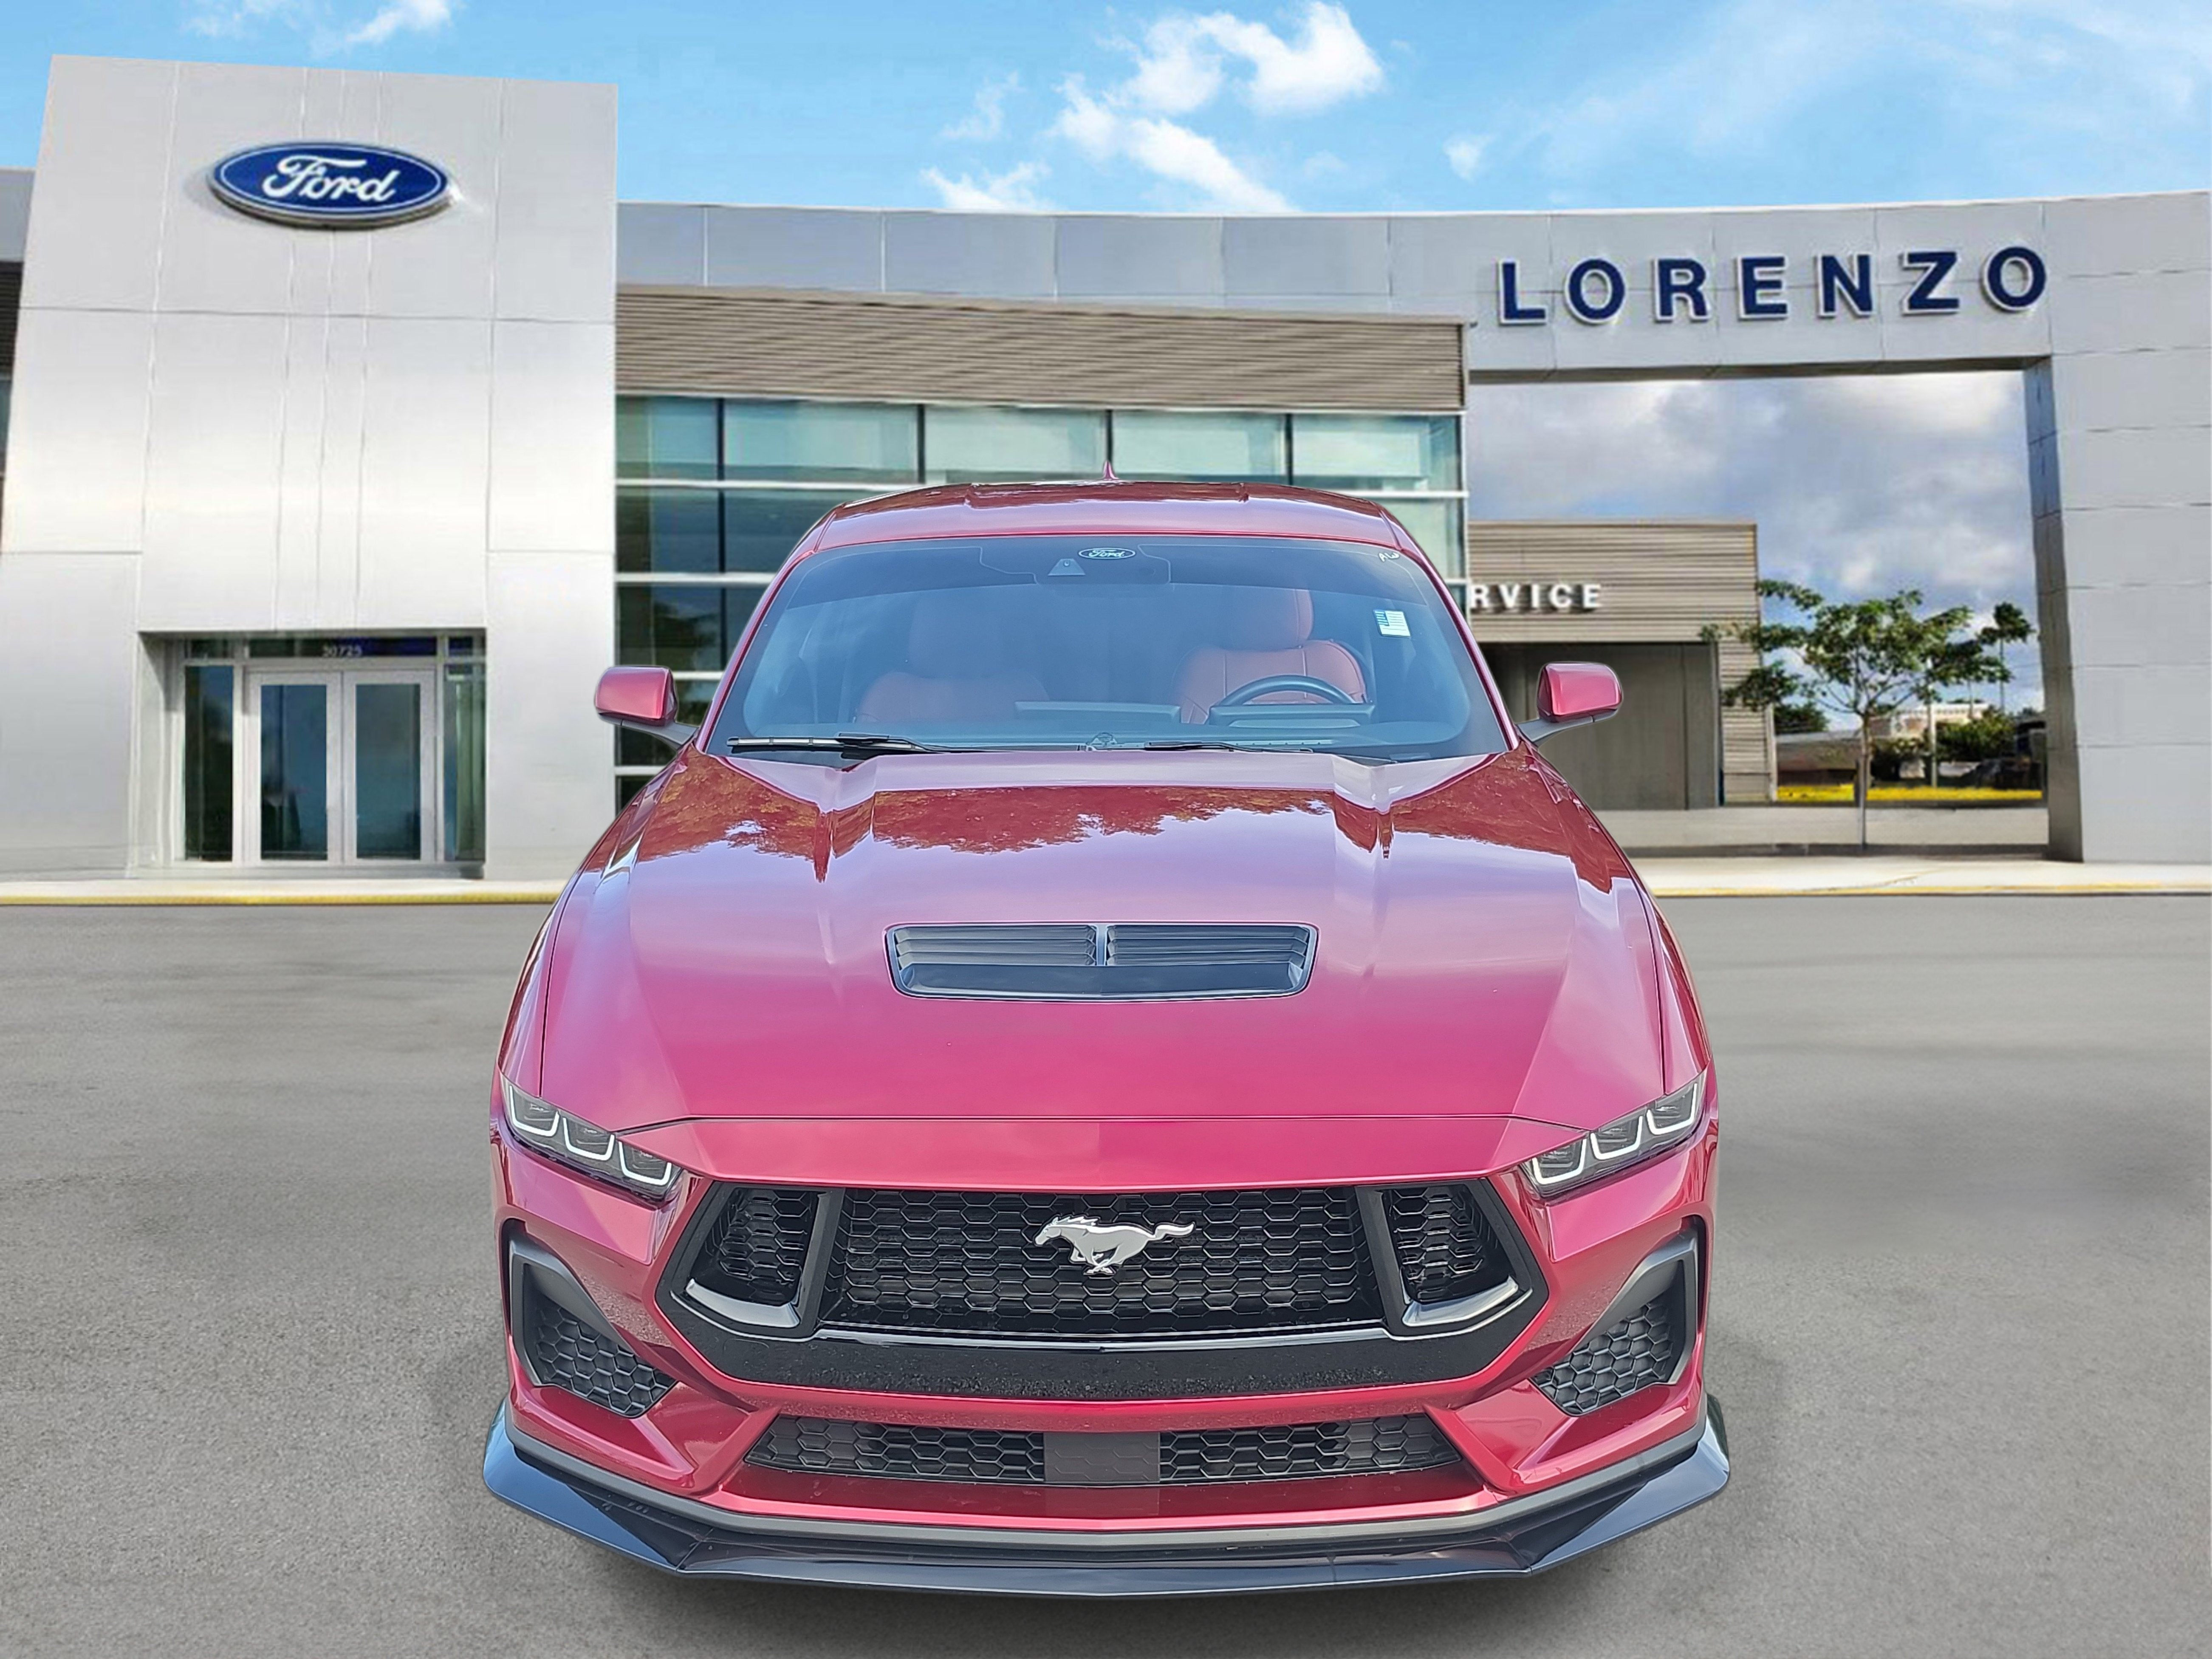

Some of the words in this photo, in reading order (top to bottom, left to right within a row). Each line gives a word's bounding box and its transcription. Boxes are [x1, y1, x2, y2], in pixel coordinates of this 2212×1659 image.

[262, 155, 401, 201] Ford
[1499, 246, 2046, 324] LORENZO
[1088, 549, 1125, 558] Ford
